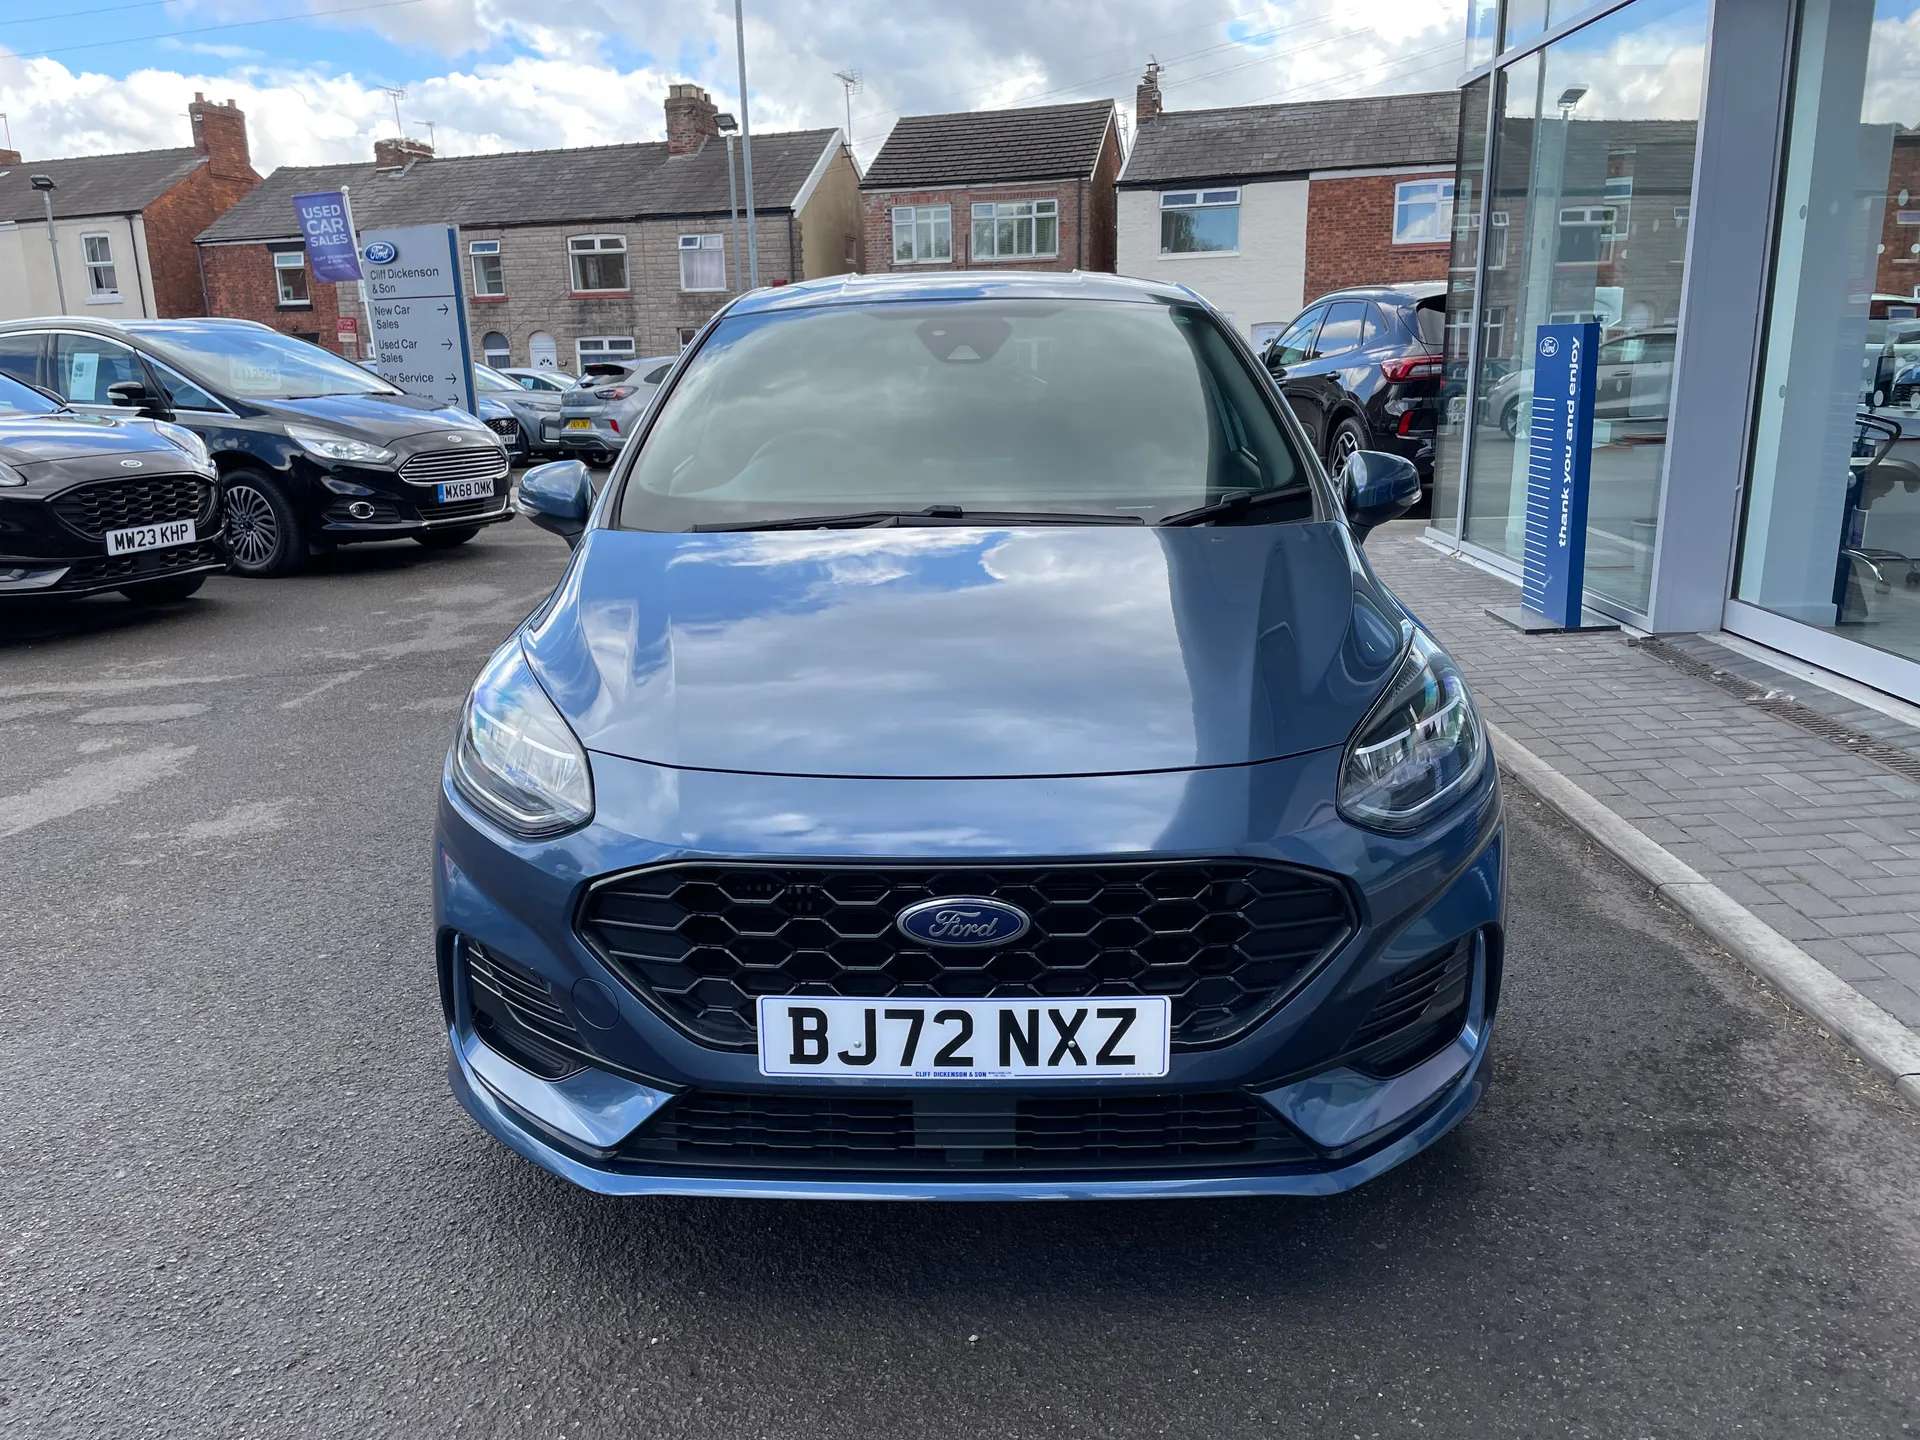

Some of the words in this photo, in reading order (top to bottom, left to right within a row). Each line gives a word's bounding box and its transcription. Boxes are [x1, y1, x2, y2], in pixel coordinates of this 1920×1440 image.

[302, 204, 341, 219] USED
[306, 217, 344, 235] CAR
[310, 233, 349, 247] SALES
[370, 269, 386, 280] Cliff
[387, 267, 439, 279] Dickenson
[372, 284, 378, 294] &
[378, 283, 396, 294] Son
[374, 305, 393, 316] New
[394, 304, 410, 316] Car
[376, 319, 400, 330] Sales
[378, 339, 400, 350] Used
[400, 338, 418, 350] Car
[380, 353, 404, 364] Sales
[1569, 336, 1581, 396] enjoy
[398, 372, 434, 383] Service
[1566, 399, 1576, 442] and
[1562, 445, 1572, 483] you
[445, 483, 472, 499] MX68
[474, 480, 493, 495] OMK
[1558, 486, 1570, 548] thank
[114, 528, 157, 551] MW23
[160, 523, 189, 544] KHP
[928, 909, 999, 938] Ford
[787, 1006, 974, 1067] BJ72
[999, 1007, 1137, 1067] NXZ
